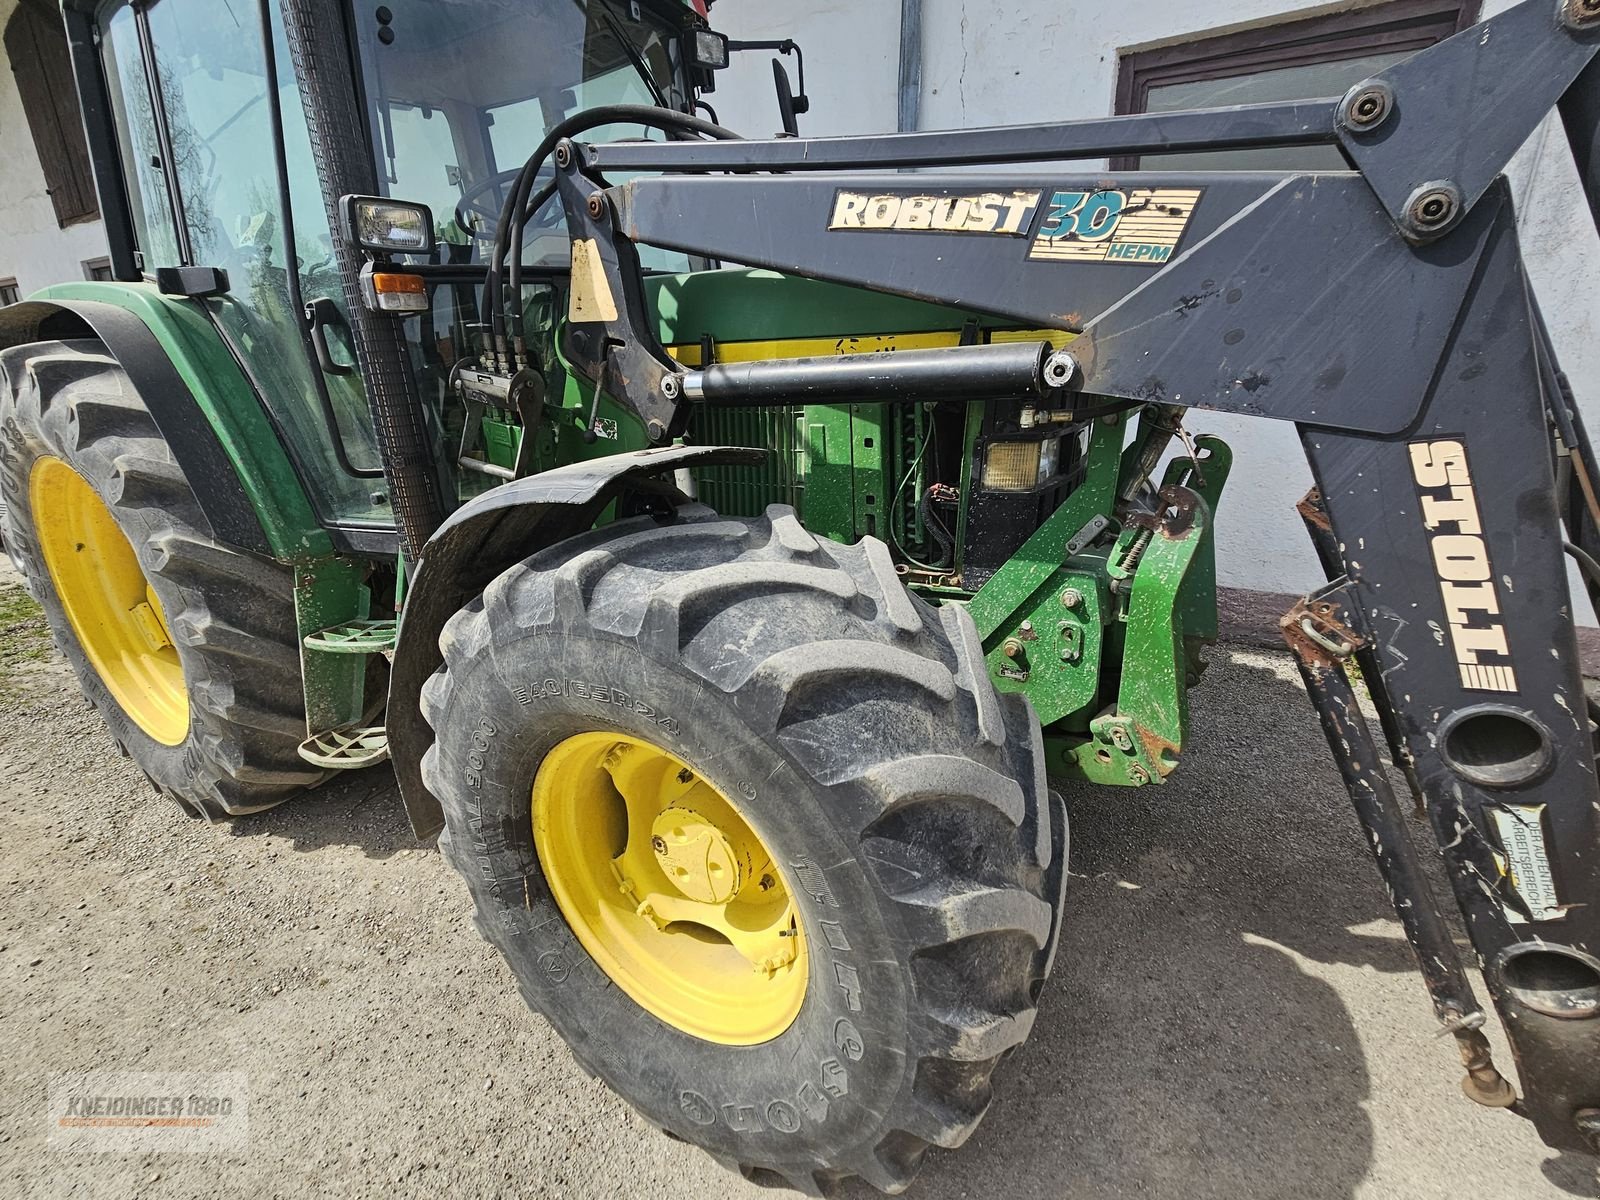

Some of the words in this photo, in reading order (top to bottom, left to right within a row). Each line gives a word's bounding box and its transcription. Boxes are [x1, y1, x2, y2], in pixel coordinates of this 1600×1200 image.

[829, 191, 1043, 234] ROBUST
[1037, 190, 1128, 242] 30
[1106, 243, 1173, 262] HEPM
[1408, 440, 1509, 665] STOLL
[1528, 821, 1542, 843] DER
[1511, 820, 1541, 908] ARBEITSBEREICH
